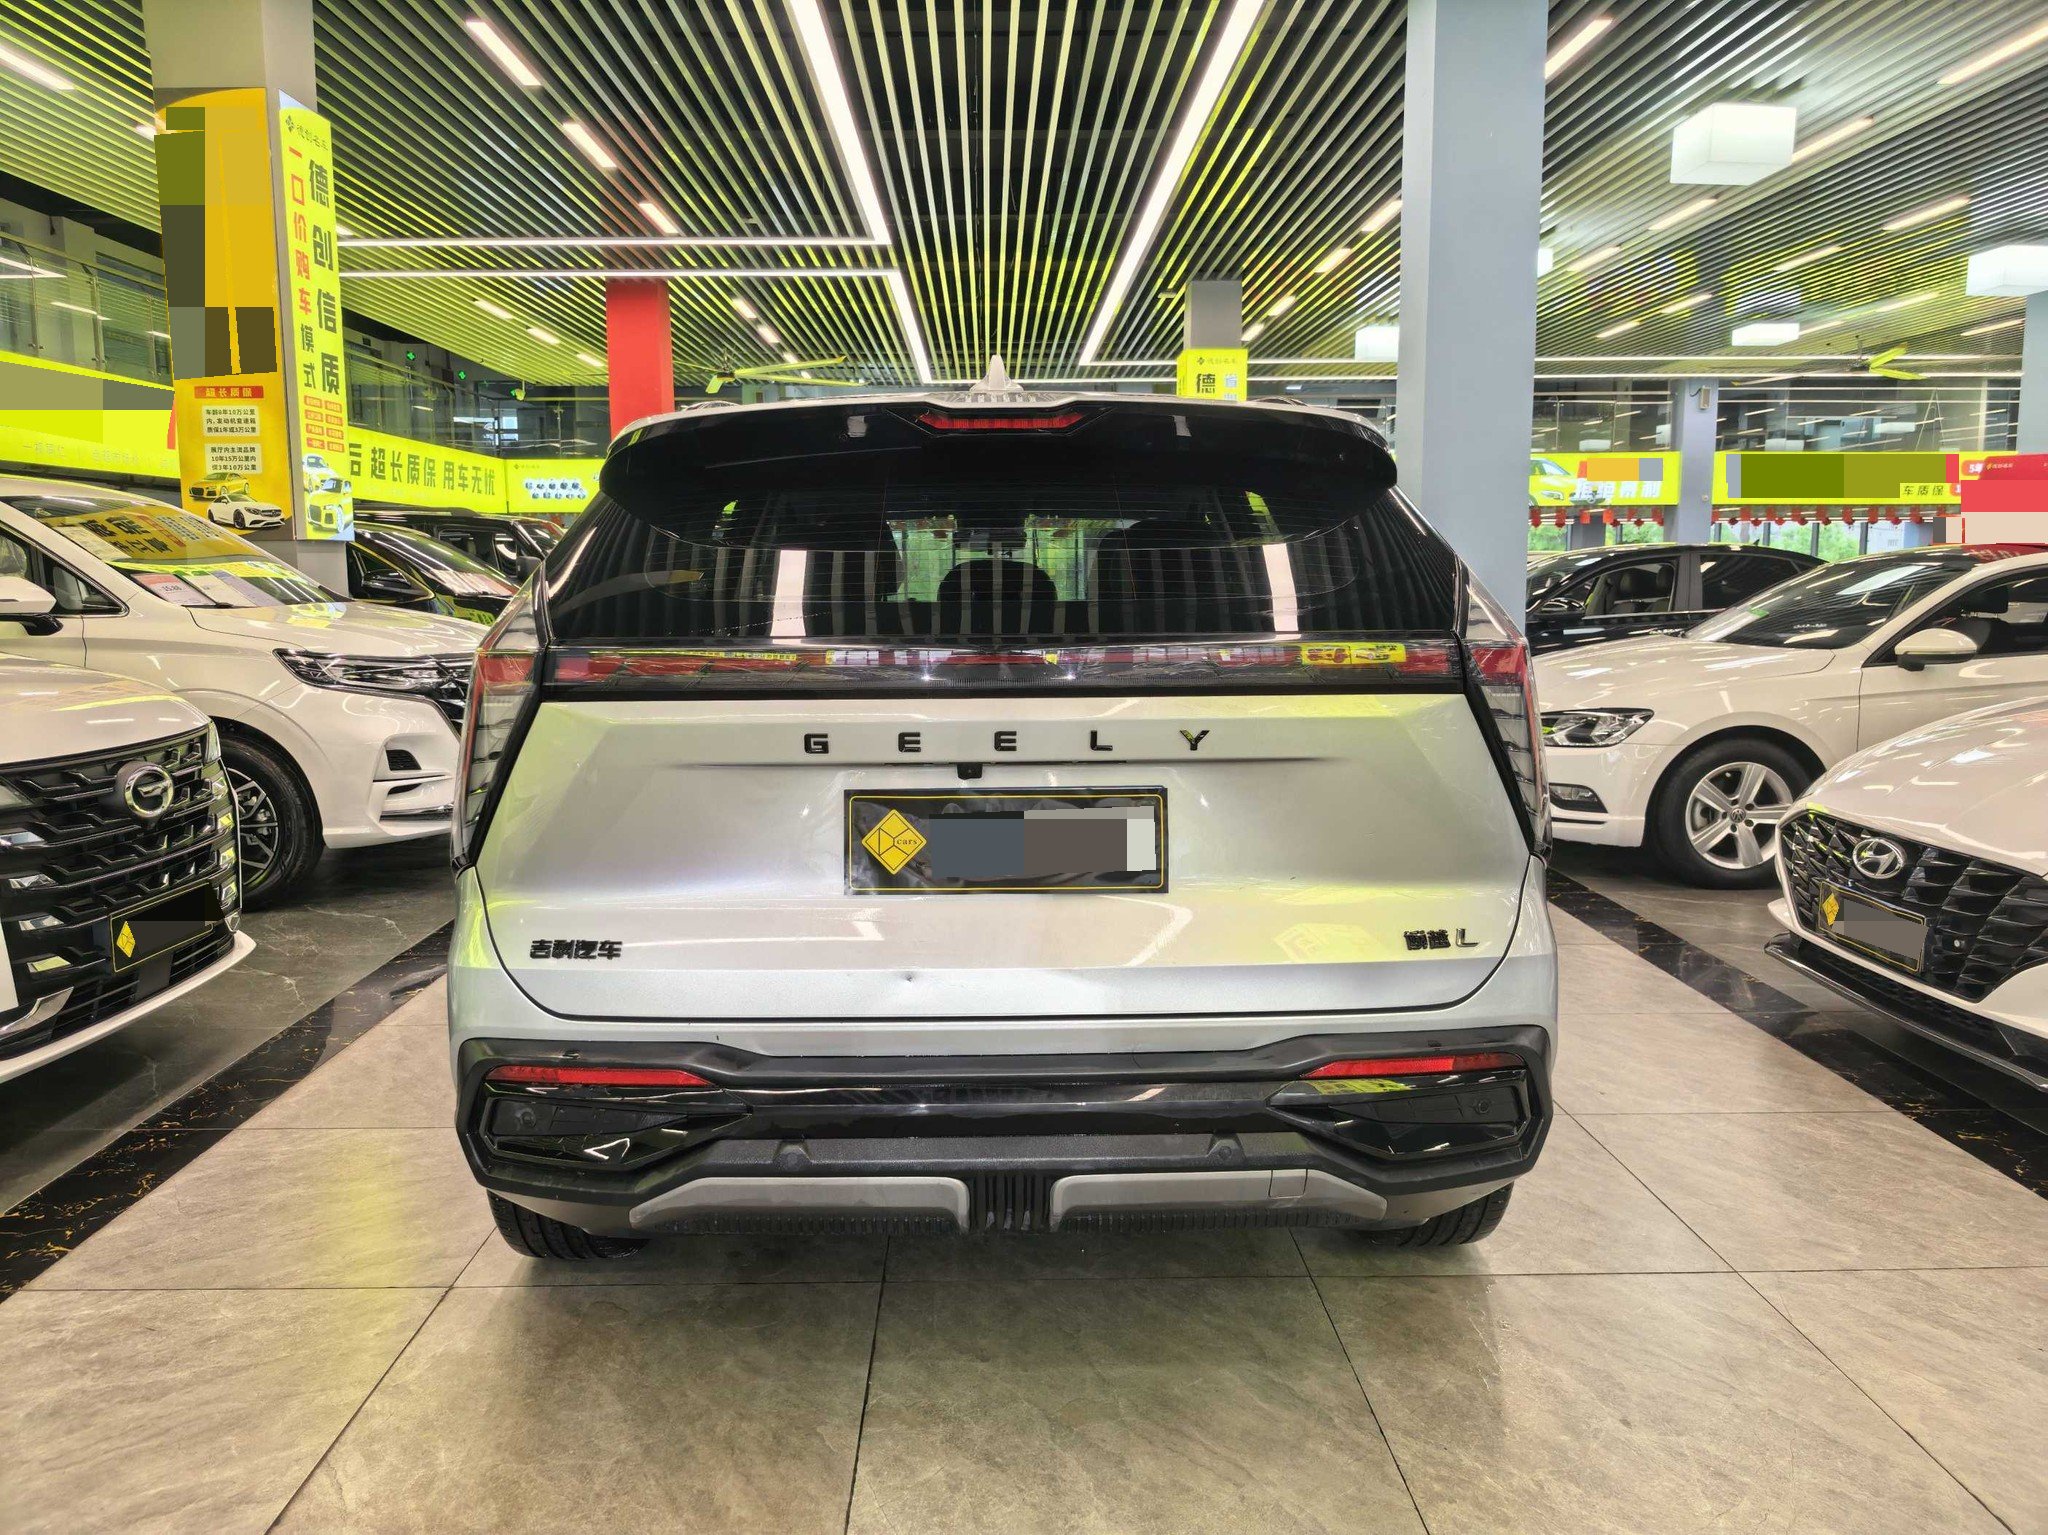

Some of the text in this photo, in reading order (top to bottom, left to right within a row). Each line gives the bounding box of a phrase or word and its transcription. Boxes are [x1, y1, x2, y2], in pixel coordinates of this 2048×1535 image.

[309, 159, 340, 396] 德创信质
[370, 446, 436, 488] 超长质保
[442, 460, 496, 496] 用车无忧
[803, 729, 1210, 755] GEELY
[530, 939, 622, 960] 吉利汽车
